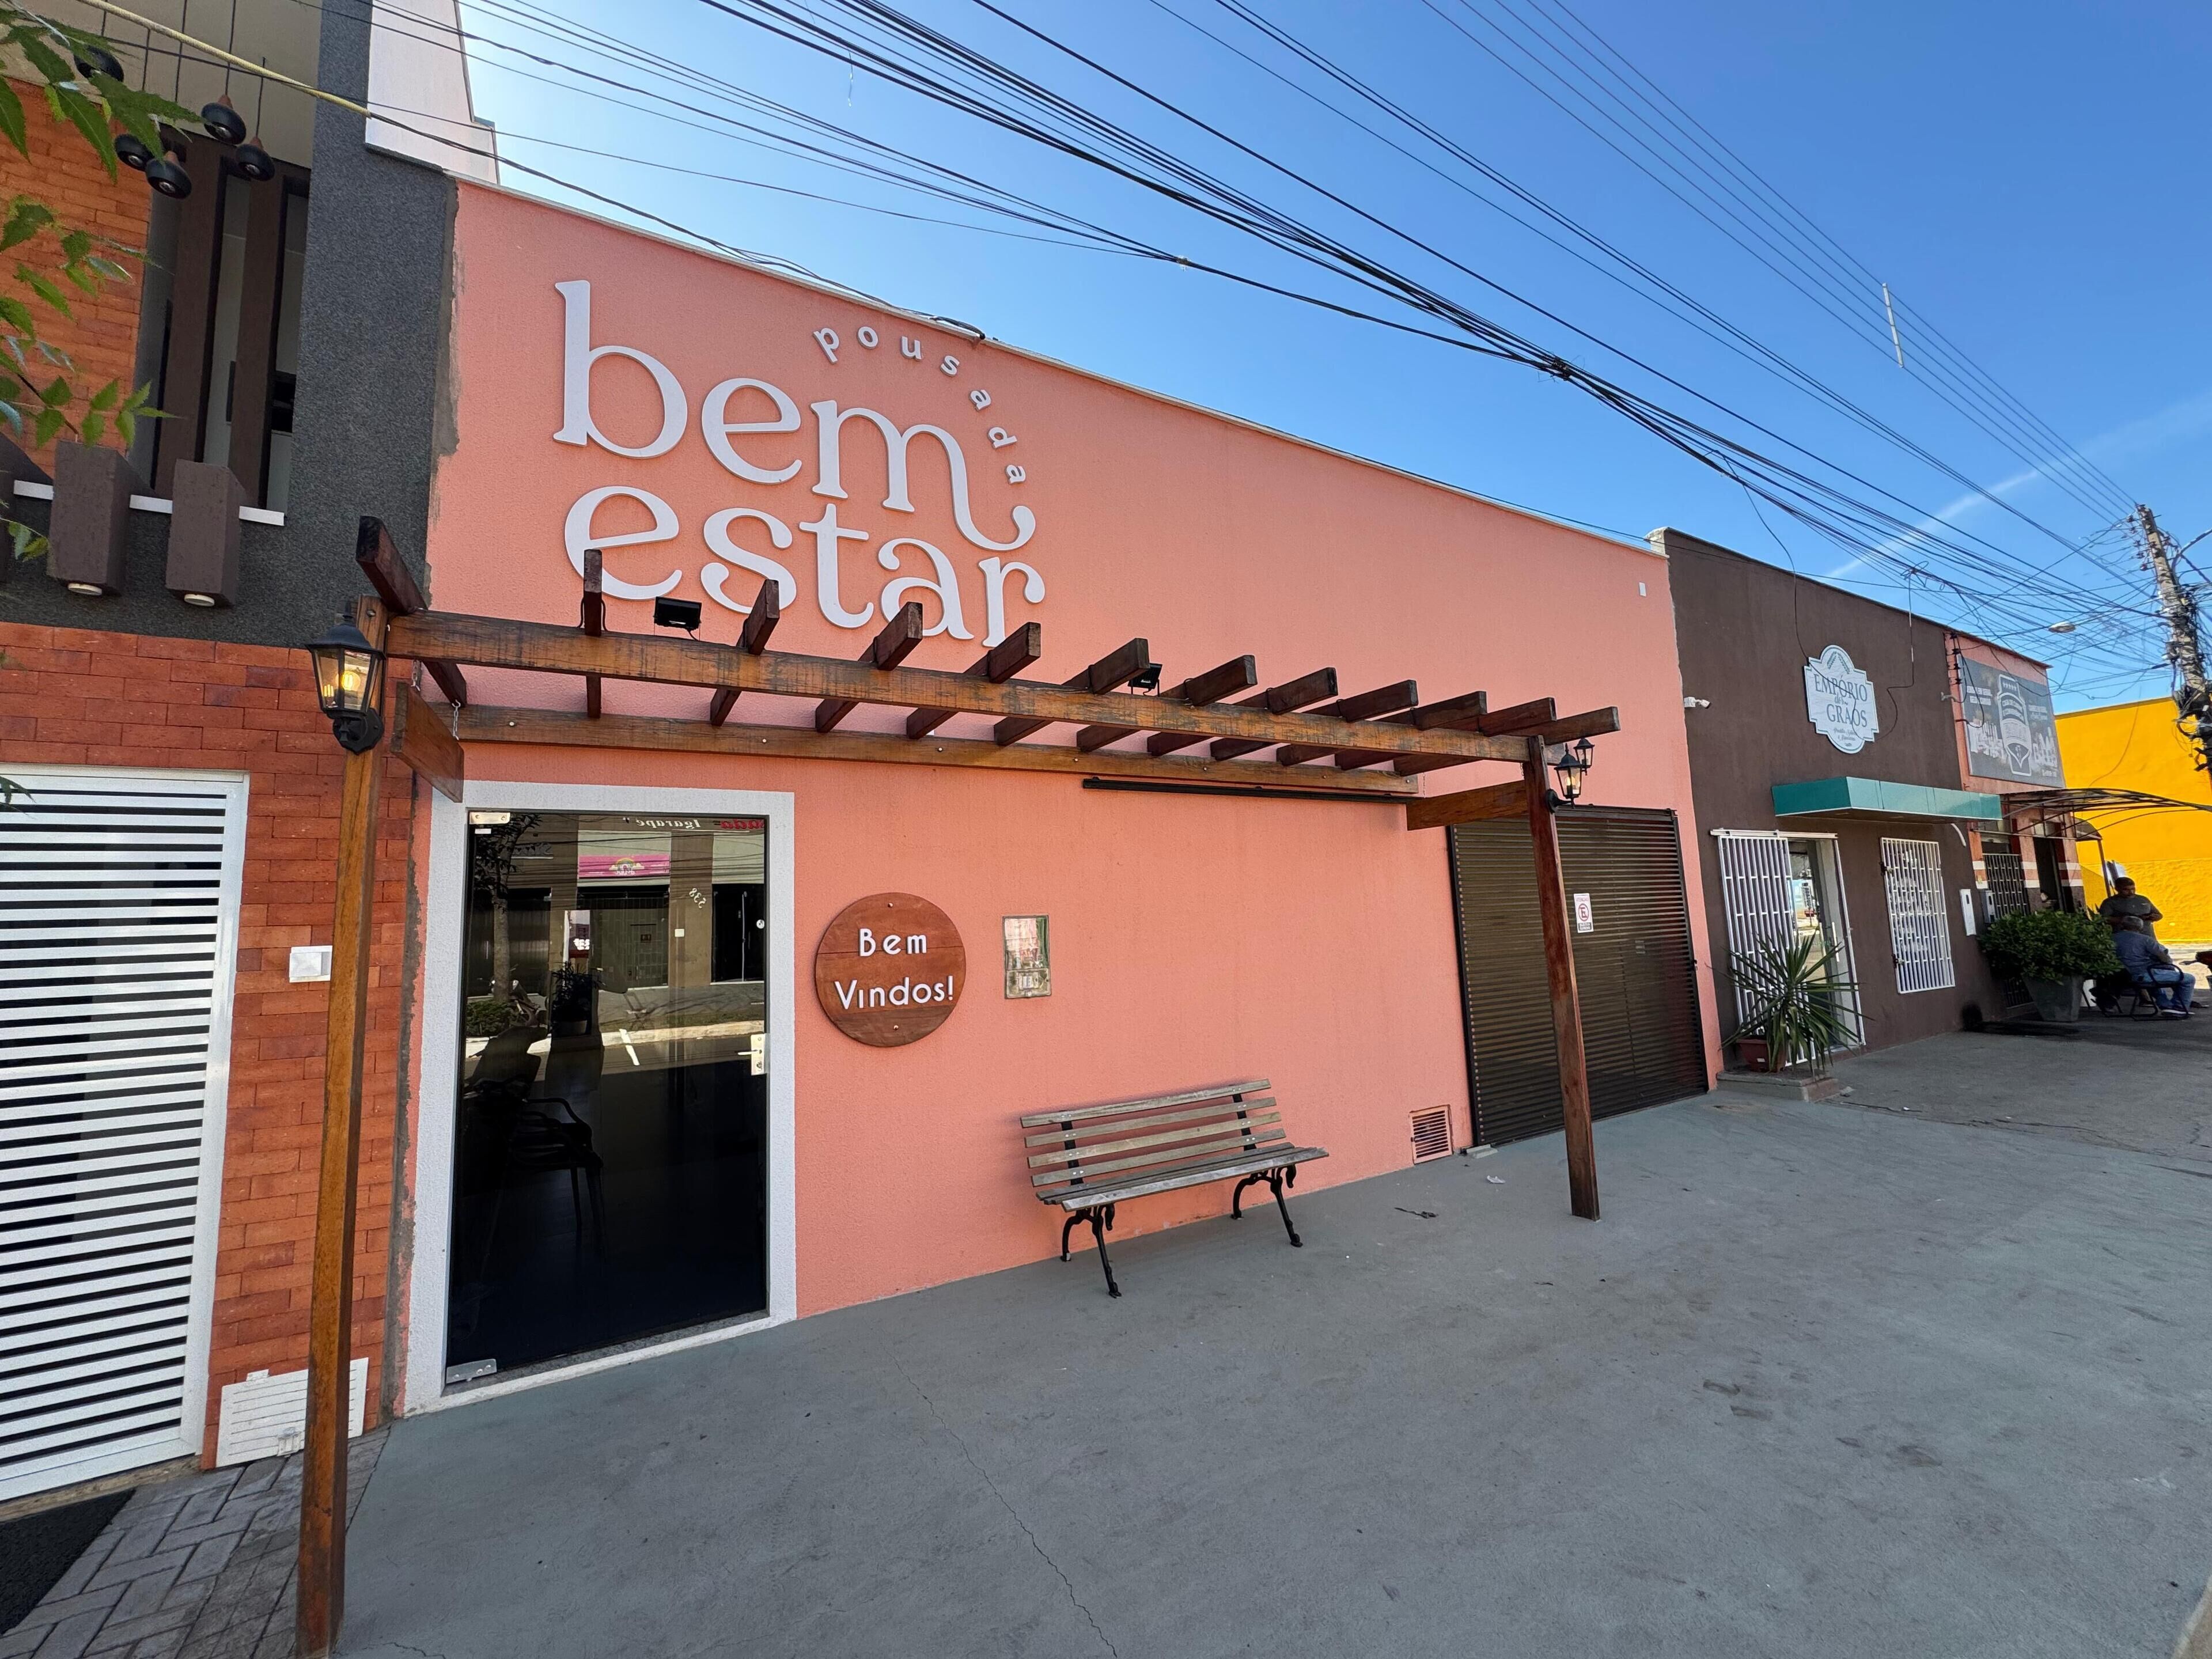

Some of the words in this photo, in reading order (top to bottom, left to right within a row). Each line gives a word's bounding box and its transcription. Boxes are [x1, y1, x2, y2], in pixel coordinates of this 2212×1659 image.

[553, 279, 1036, 552] bem
[813, 325, 1027, 484] pousada
[565, 486, 1046, 648] estar
[1813, 673, 1868, 702] EMPÓRIO
[859, 928, 927, 957] Bem
[834, 975, 953, 1010] Vindos!
